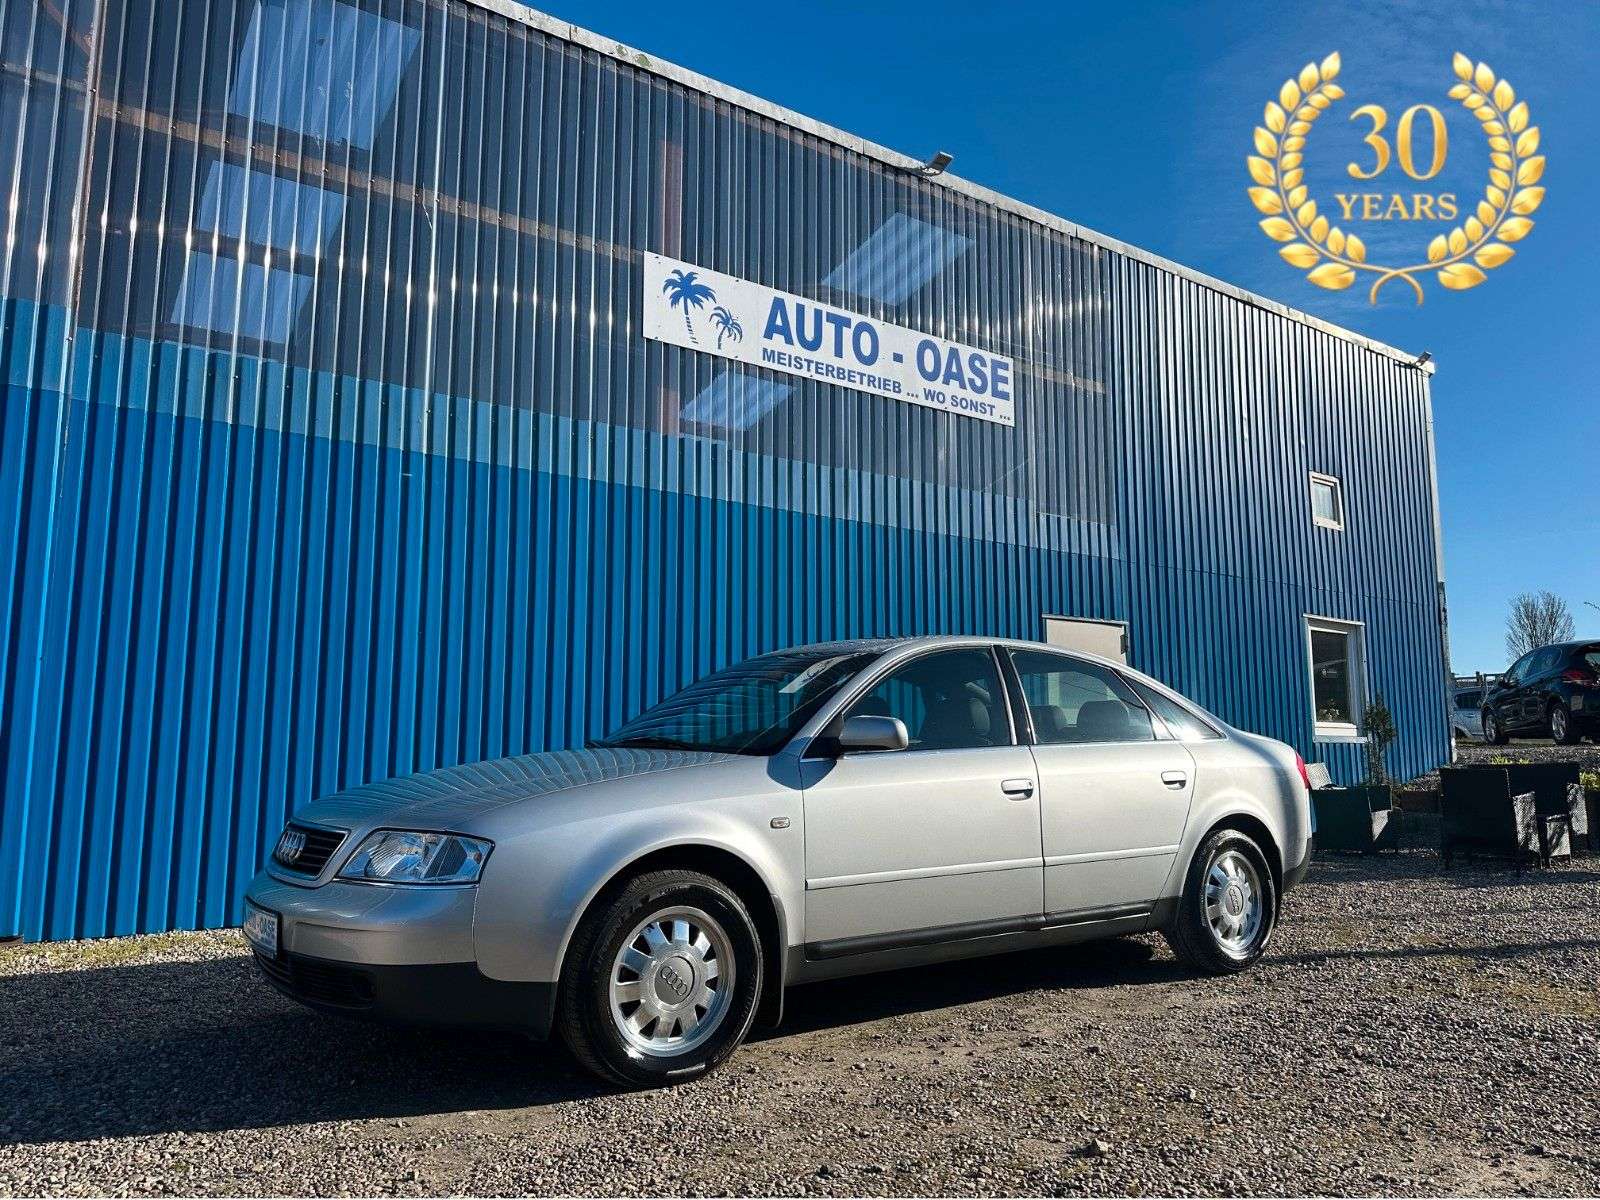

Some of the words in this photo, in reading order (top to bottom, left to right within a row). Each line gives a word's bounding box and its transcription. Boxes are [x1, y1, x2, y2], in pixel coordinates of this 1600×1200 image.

[762, 347, 902, 394] MEISTERBETRIEB
[923, 387, 946, 404] WO
[950, 395, 996, 417] SONST
[763, 296, 880, 367] AUTO
[892, 352, 904, 364] -
[916, 338, 1010, 401] OASE
